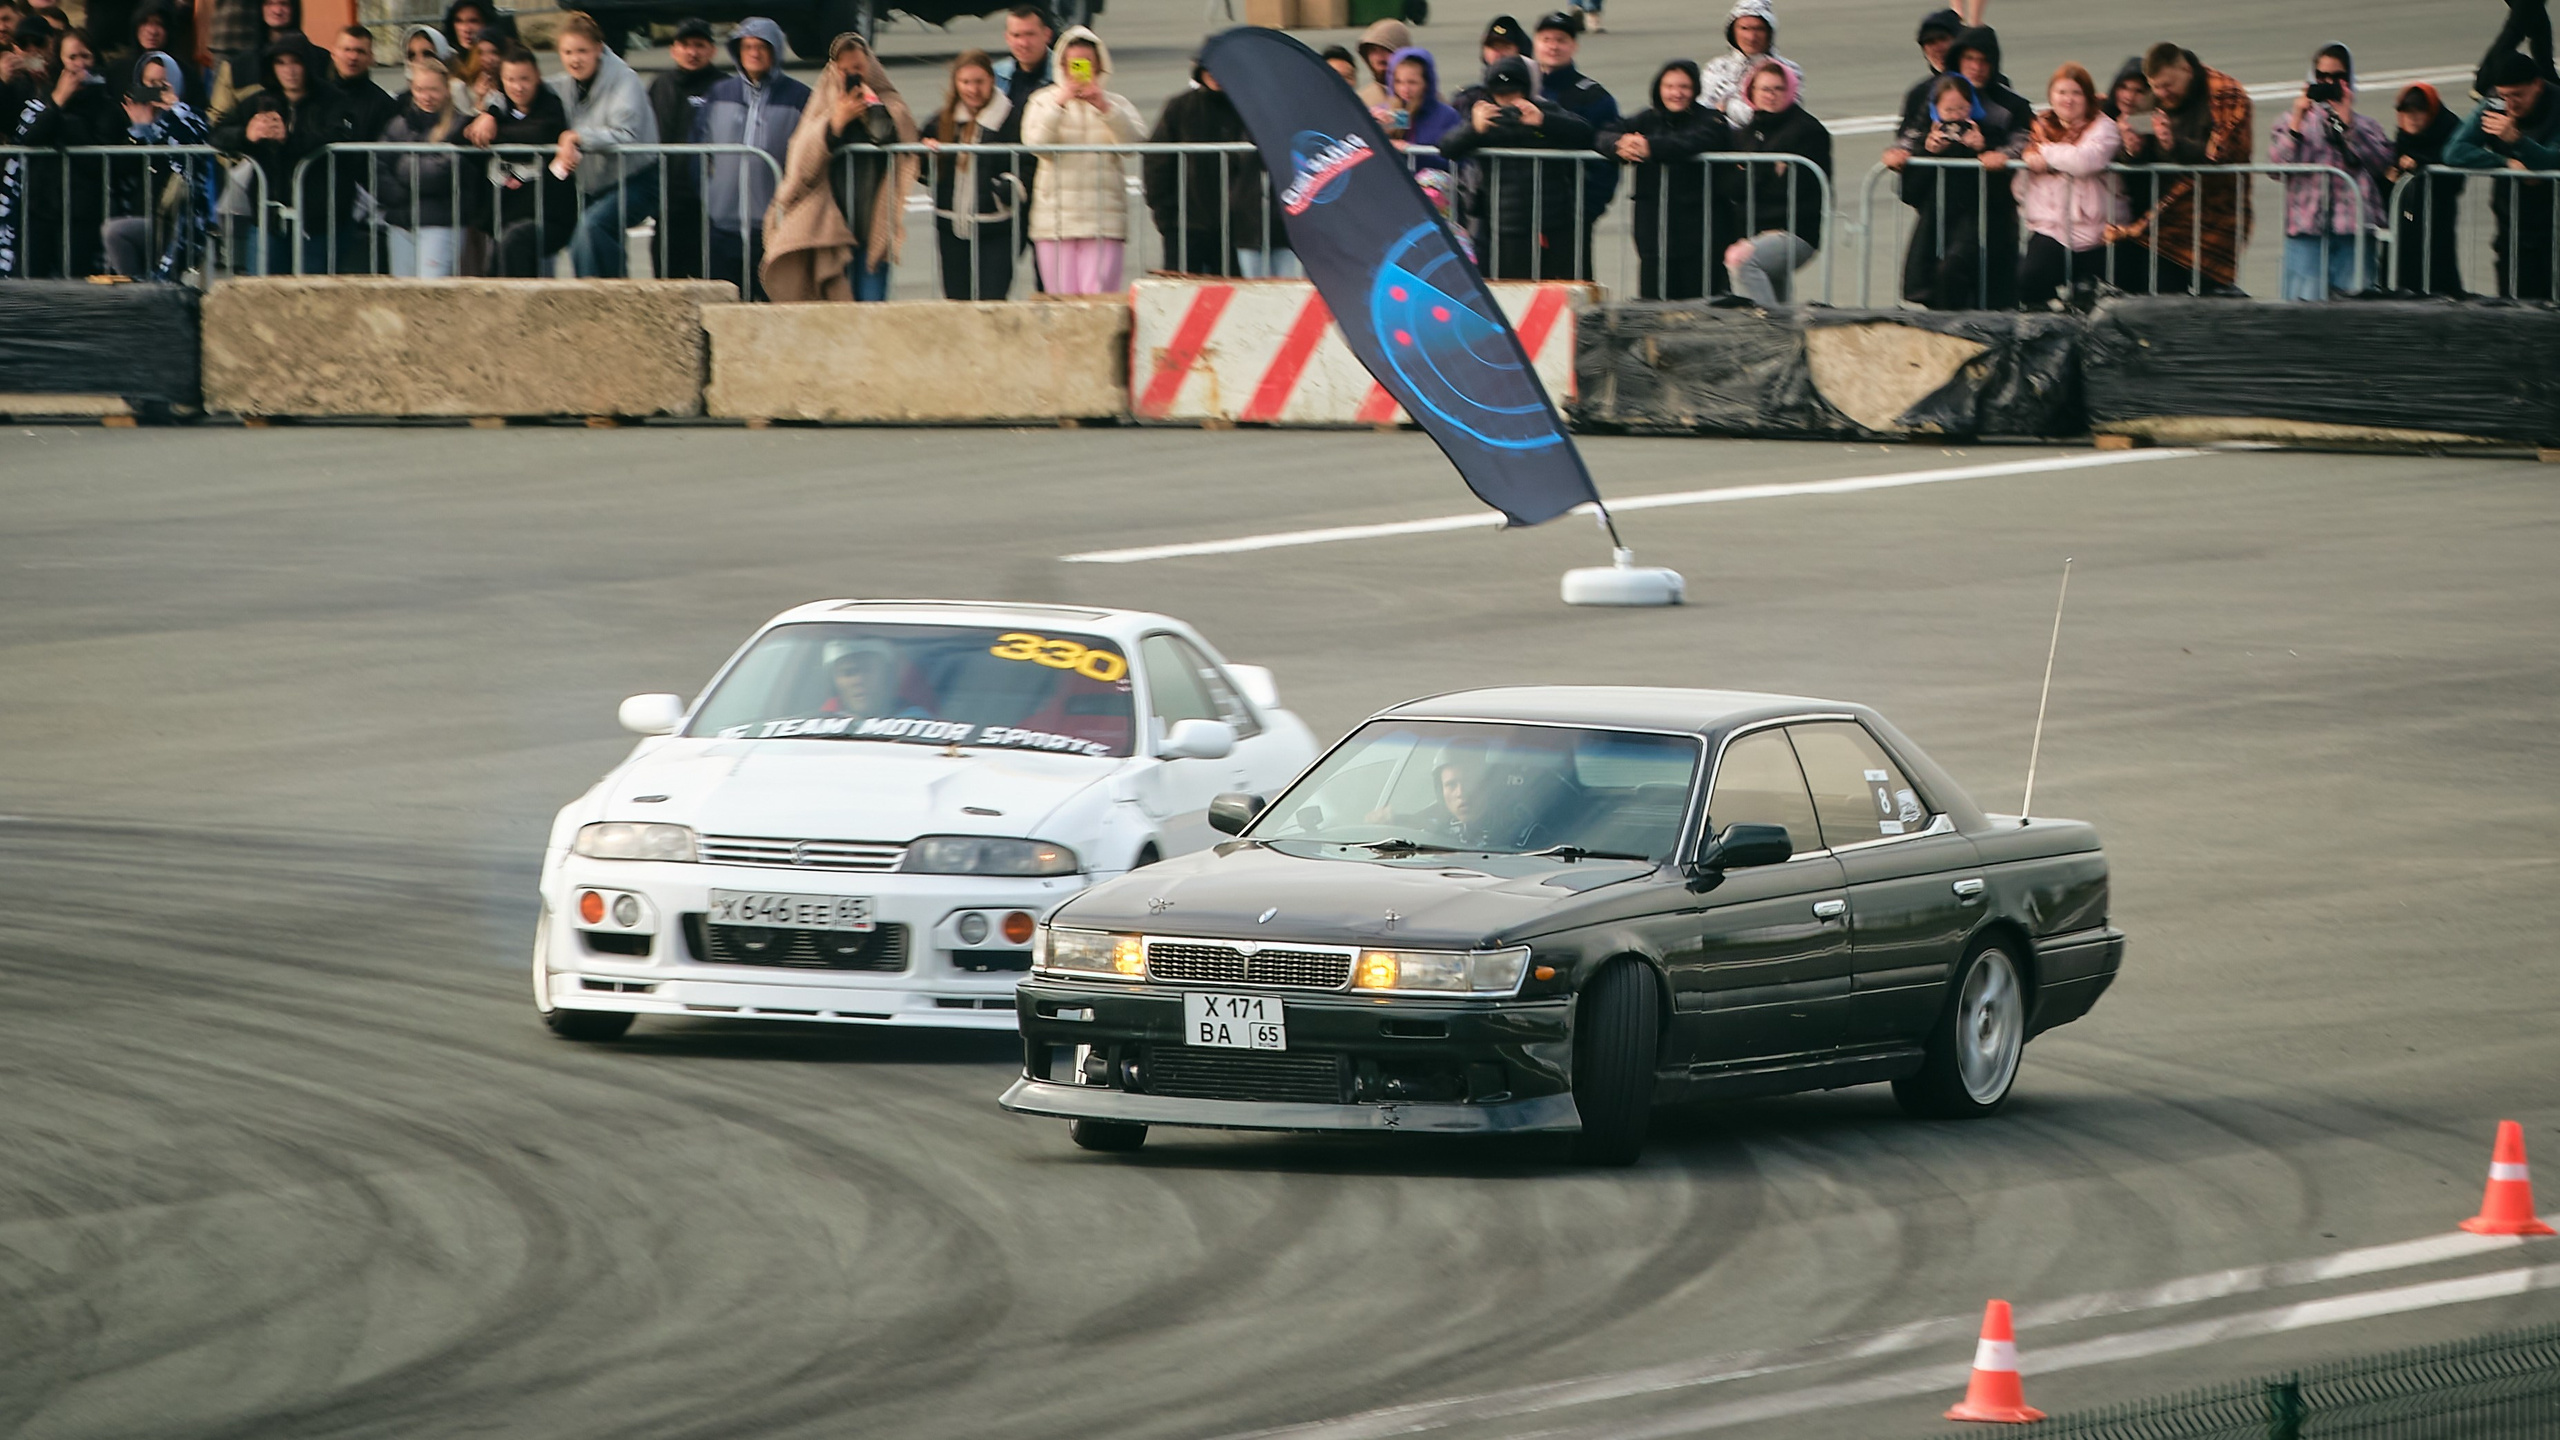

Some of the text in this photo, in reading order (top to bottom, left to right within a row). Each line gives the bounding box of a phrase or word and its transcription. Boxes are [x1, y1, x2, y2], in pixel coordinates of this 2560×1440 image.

[990, 632, 1127, 682] 330
[758, 717, 854, 738] TEAM
[854, 717, 976, 741] MOTOR
[1877, 786, 1892, 815] 8
[1258, 1026, 1279, 1042] 65
